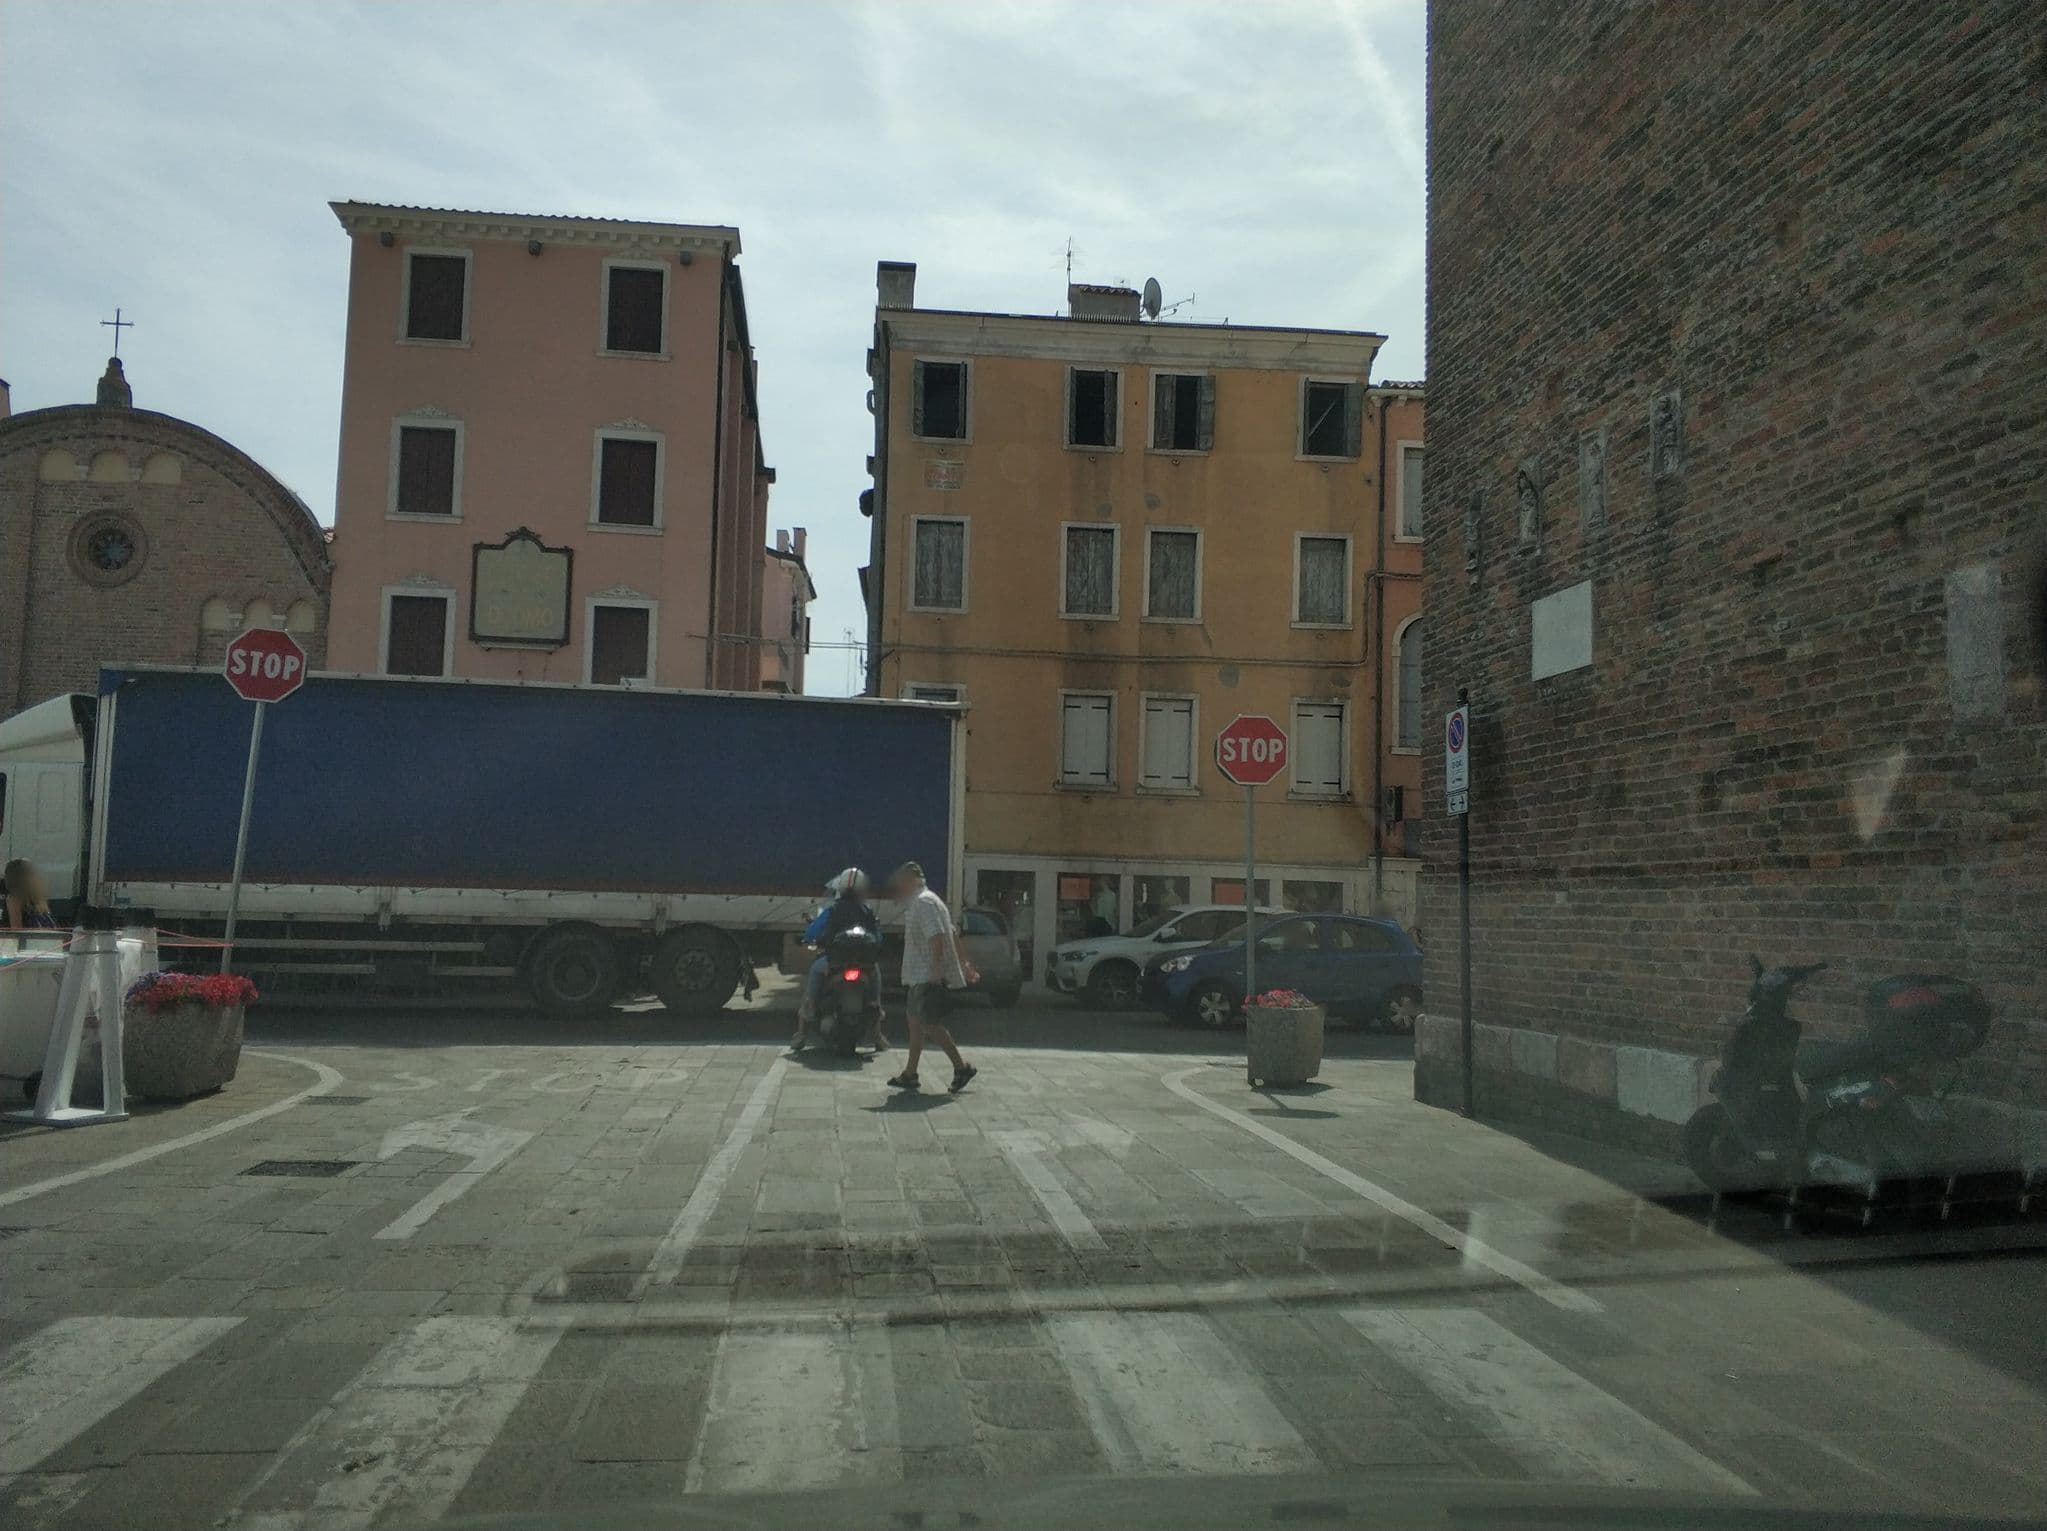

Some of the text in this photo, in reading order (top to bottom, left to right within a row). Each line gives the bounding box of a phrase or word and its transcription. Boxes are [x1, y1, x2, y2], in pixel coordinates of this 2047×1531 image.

[230, 648, 300, 681] STOP
[1222, 737, 1284, 763] STOP
[370, 1067, 689, 1092] STOP
